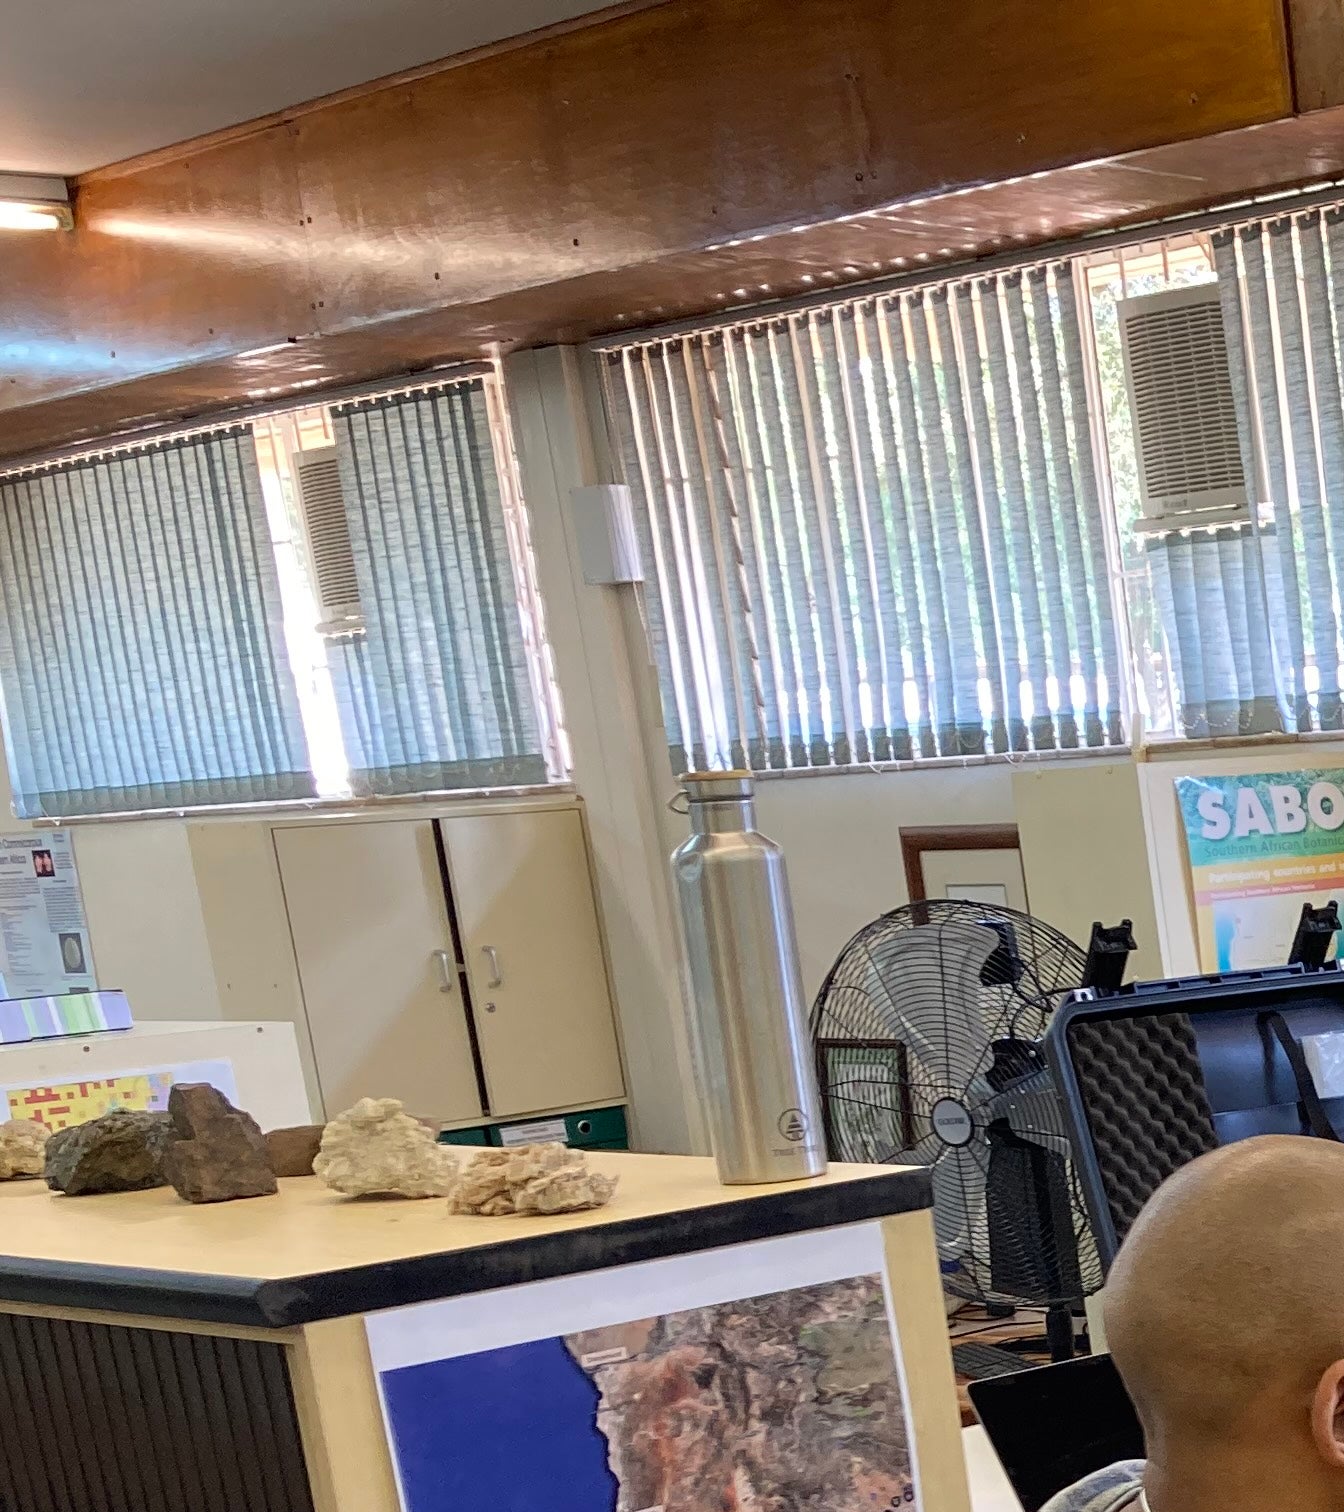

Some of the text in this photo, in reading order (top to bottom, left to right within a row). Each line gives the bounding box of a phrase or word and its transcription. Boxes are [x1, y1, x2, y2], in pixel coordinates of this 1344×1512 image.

[1205, 843, 1257, 858] Southern
[1261, 841, 1300, 853] African
[1320, 863, 1336, 873] and
